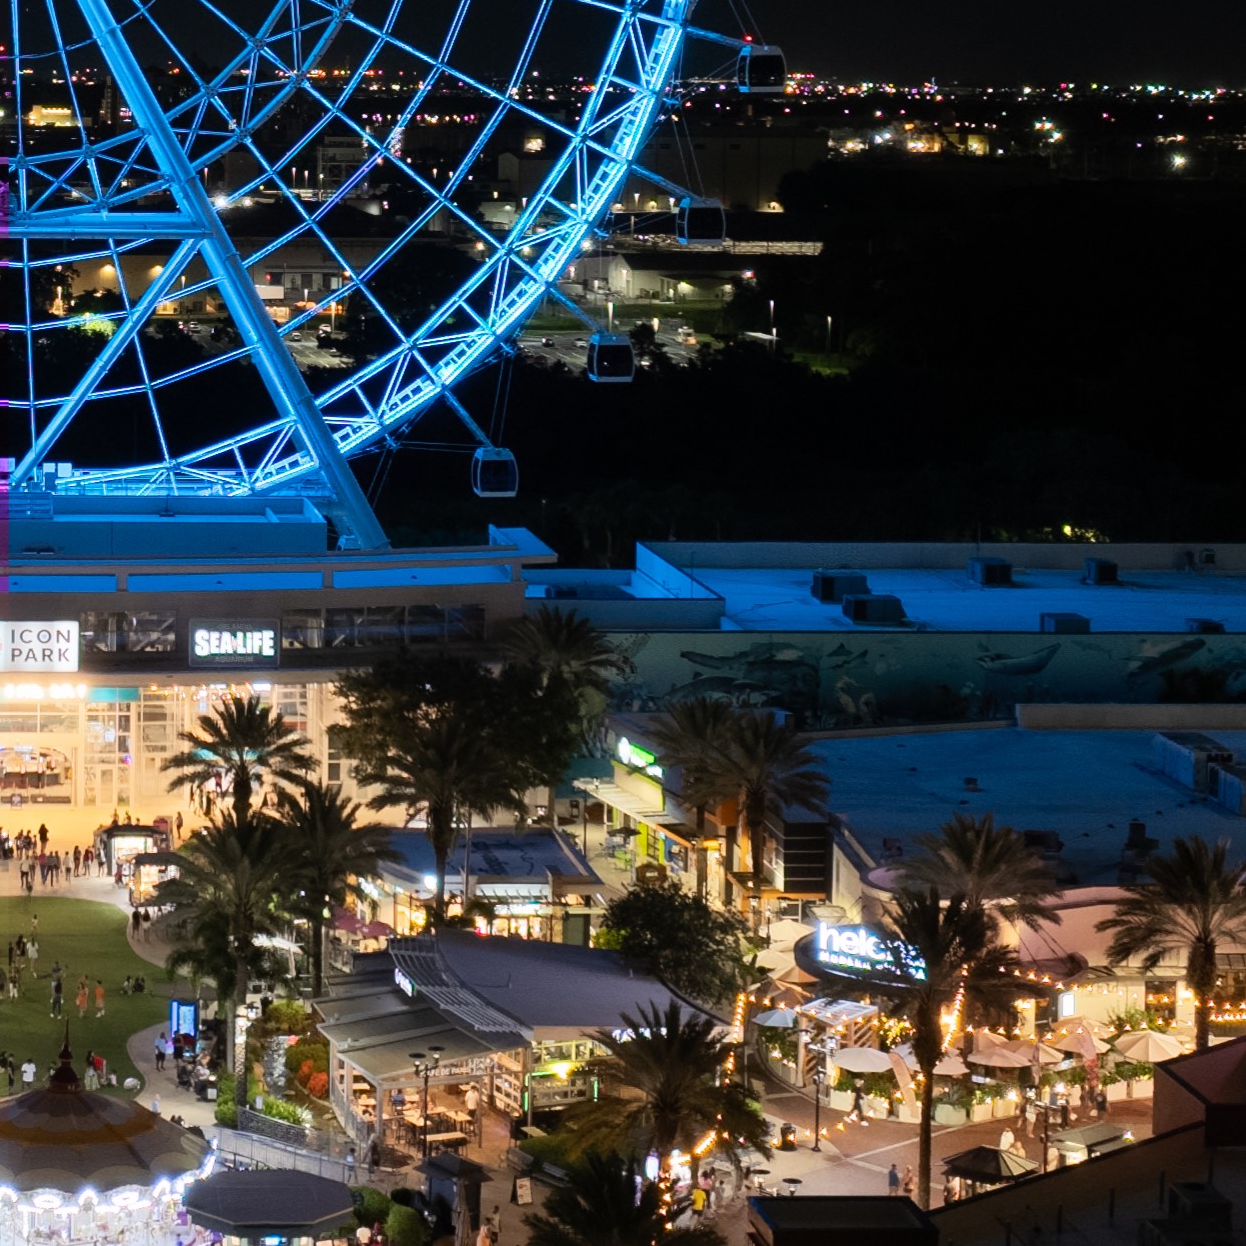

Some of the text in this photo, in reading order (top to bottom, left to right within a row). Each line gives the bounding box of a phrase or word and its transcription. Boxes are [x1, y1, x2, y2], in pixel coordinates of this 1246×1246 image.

[11, 629, 70, 644] ICON
[194, 629, 234, 656] SEA
[11, 648, 70, 662] PARK
